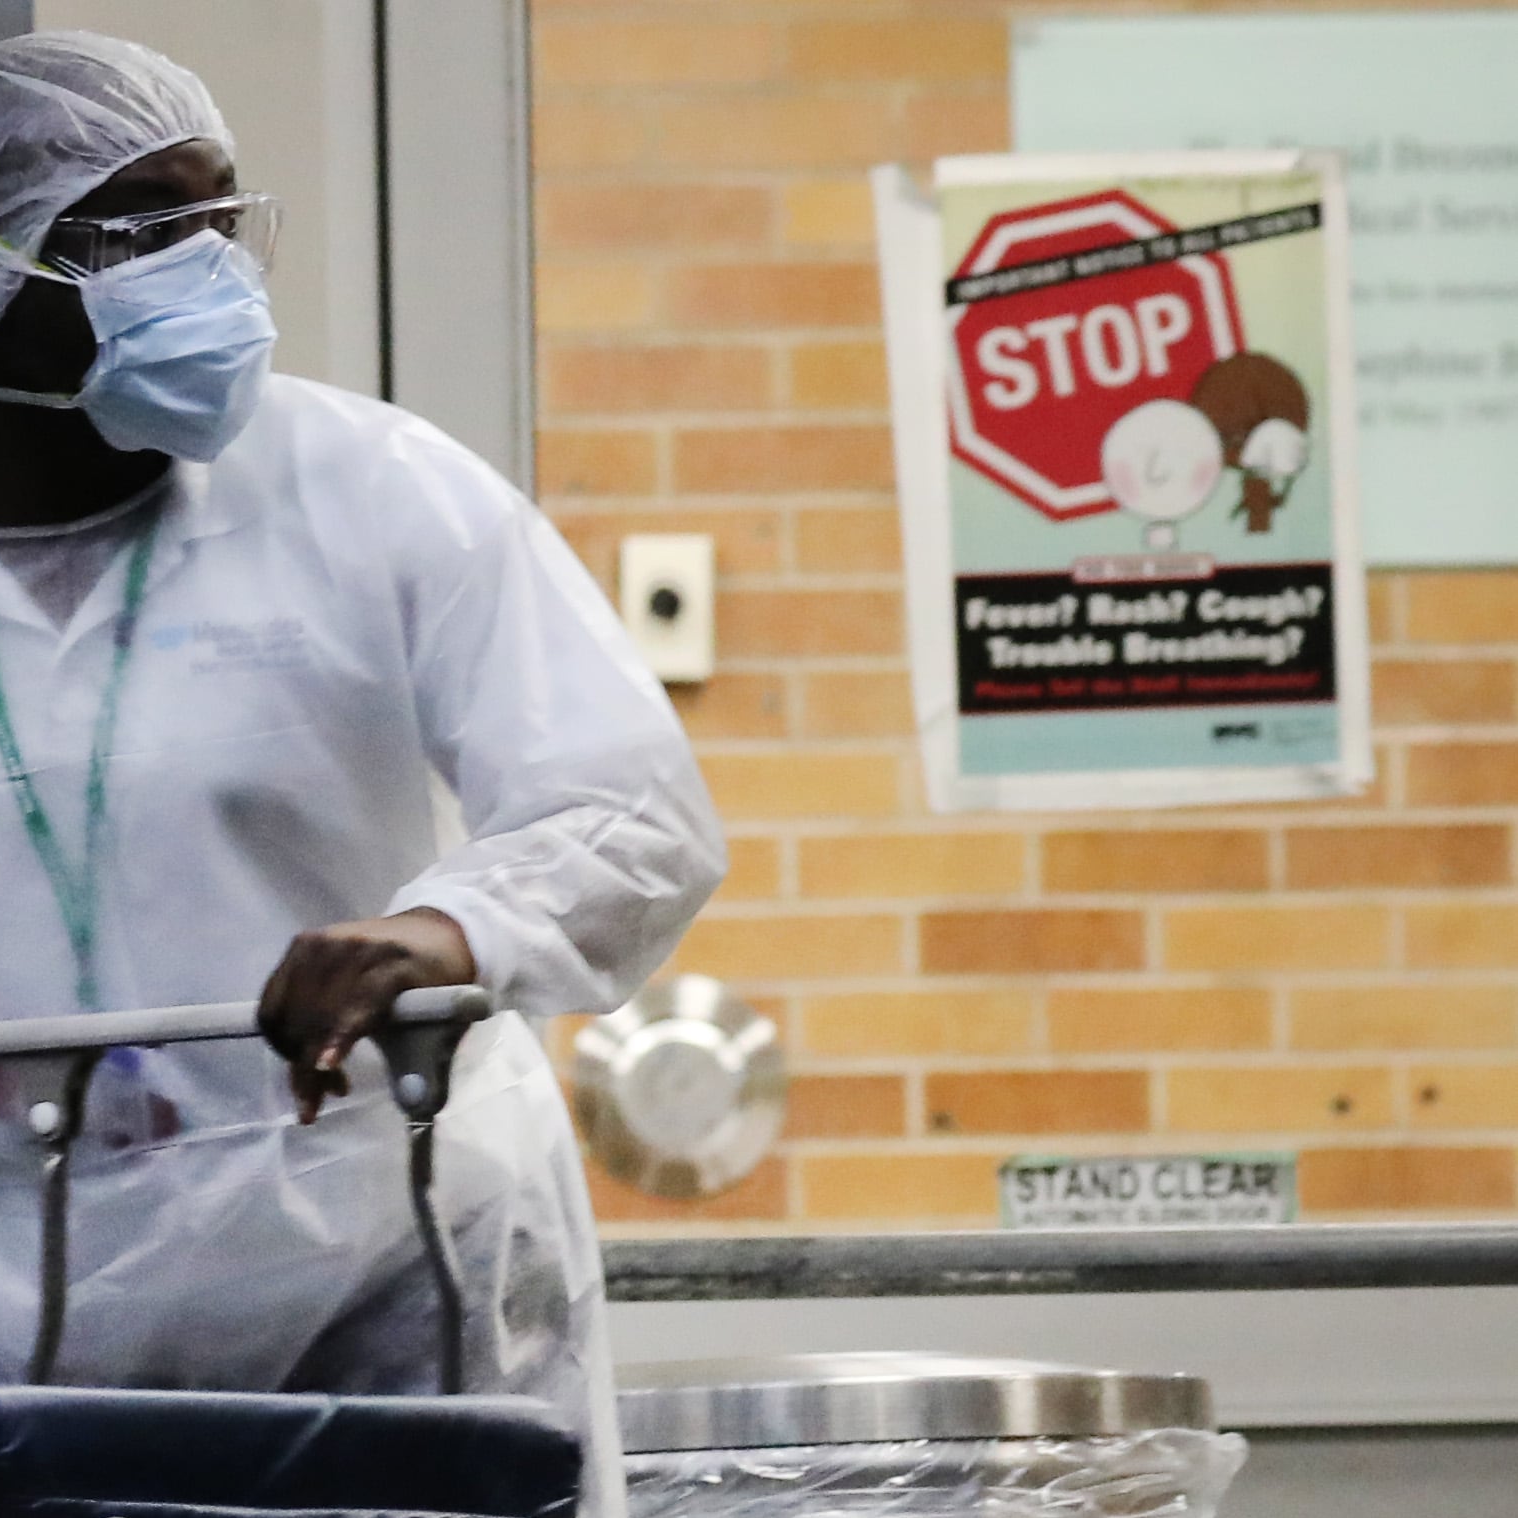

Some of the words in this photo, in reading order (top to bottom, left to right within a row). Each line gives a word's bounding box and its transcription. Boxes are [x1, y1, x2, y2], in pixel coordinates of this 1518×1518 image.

[976, 292, 1191, 411] STOP
[966, 594, 1079, 631] Fever?
[1086, 590, 1189, 626] Rash?
[1196, 584, 1325, 627] Cough?
[985, 634, 1115, 668] Trouble
[1122, 625, 1305, 667] Breathing?
[1016, 1161, 1140, 1202] STAND
[1151, 1160, 1279, 1200] CLEAR
